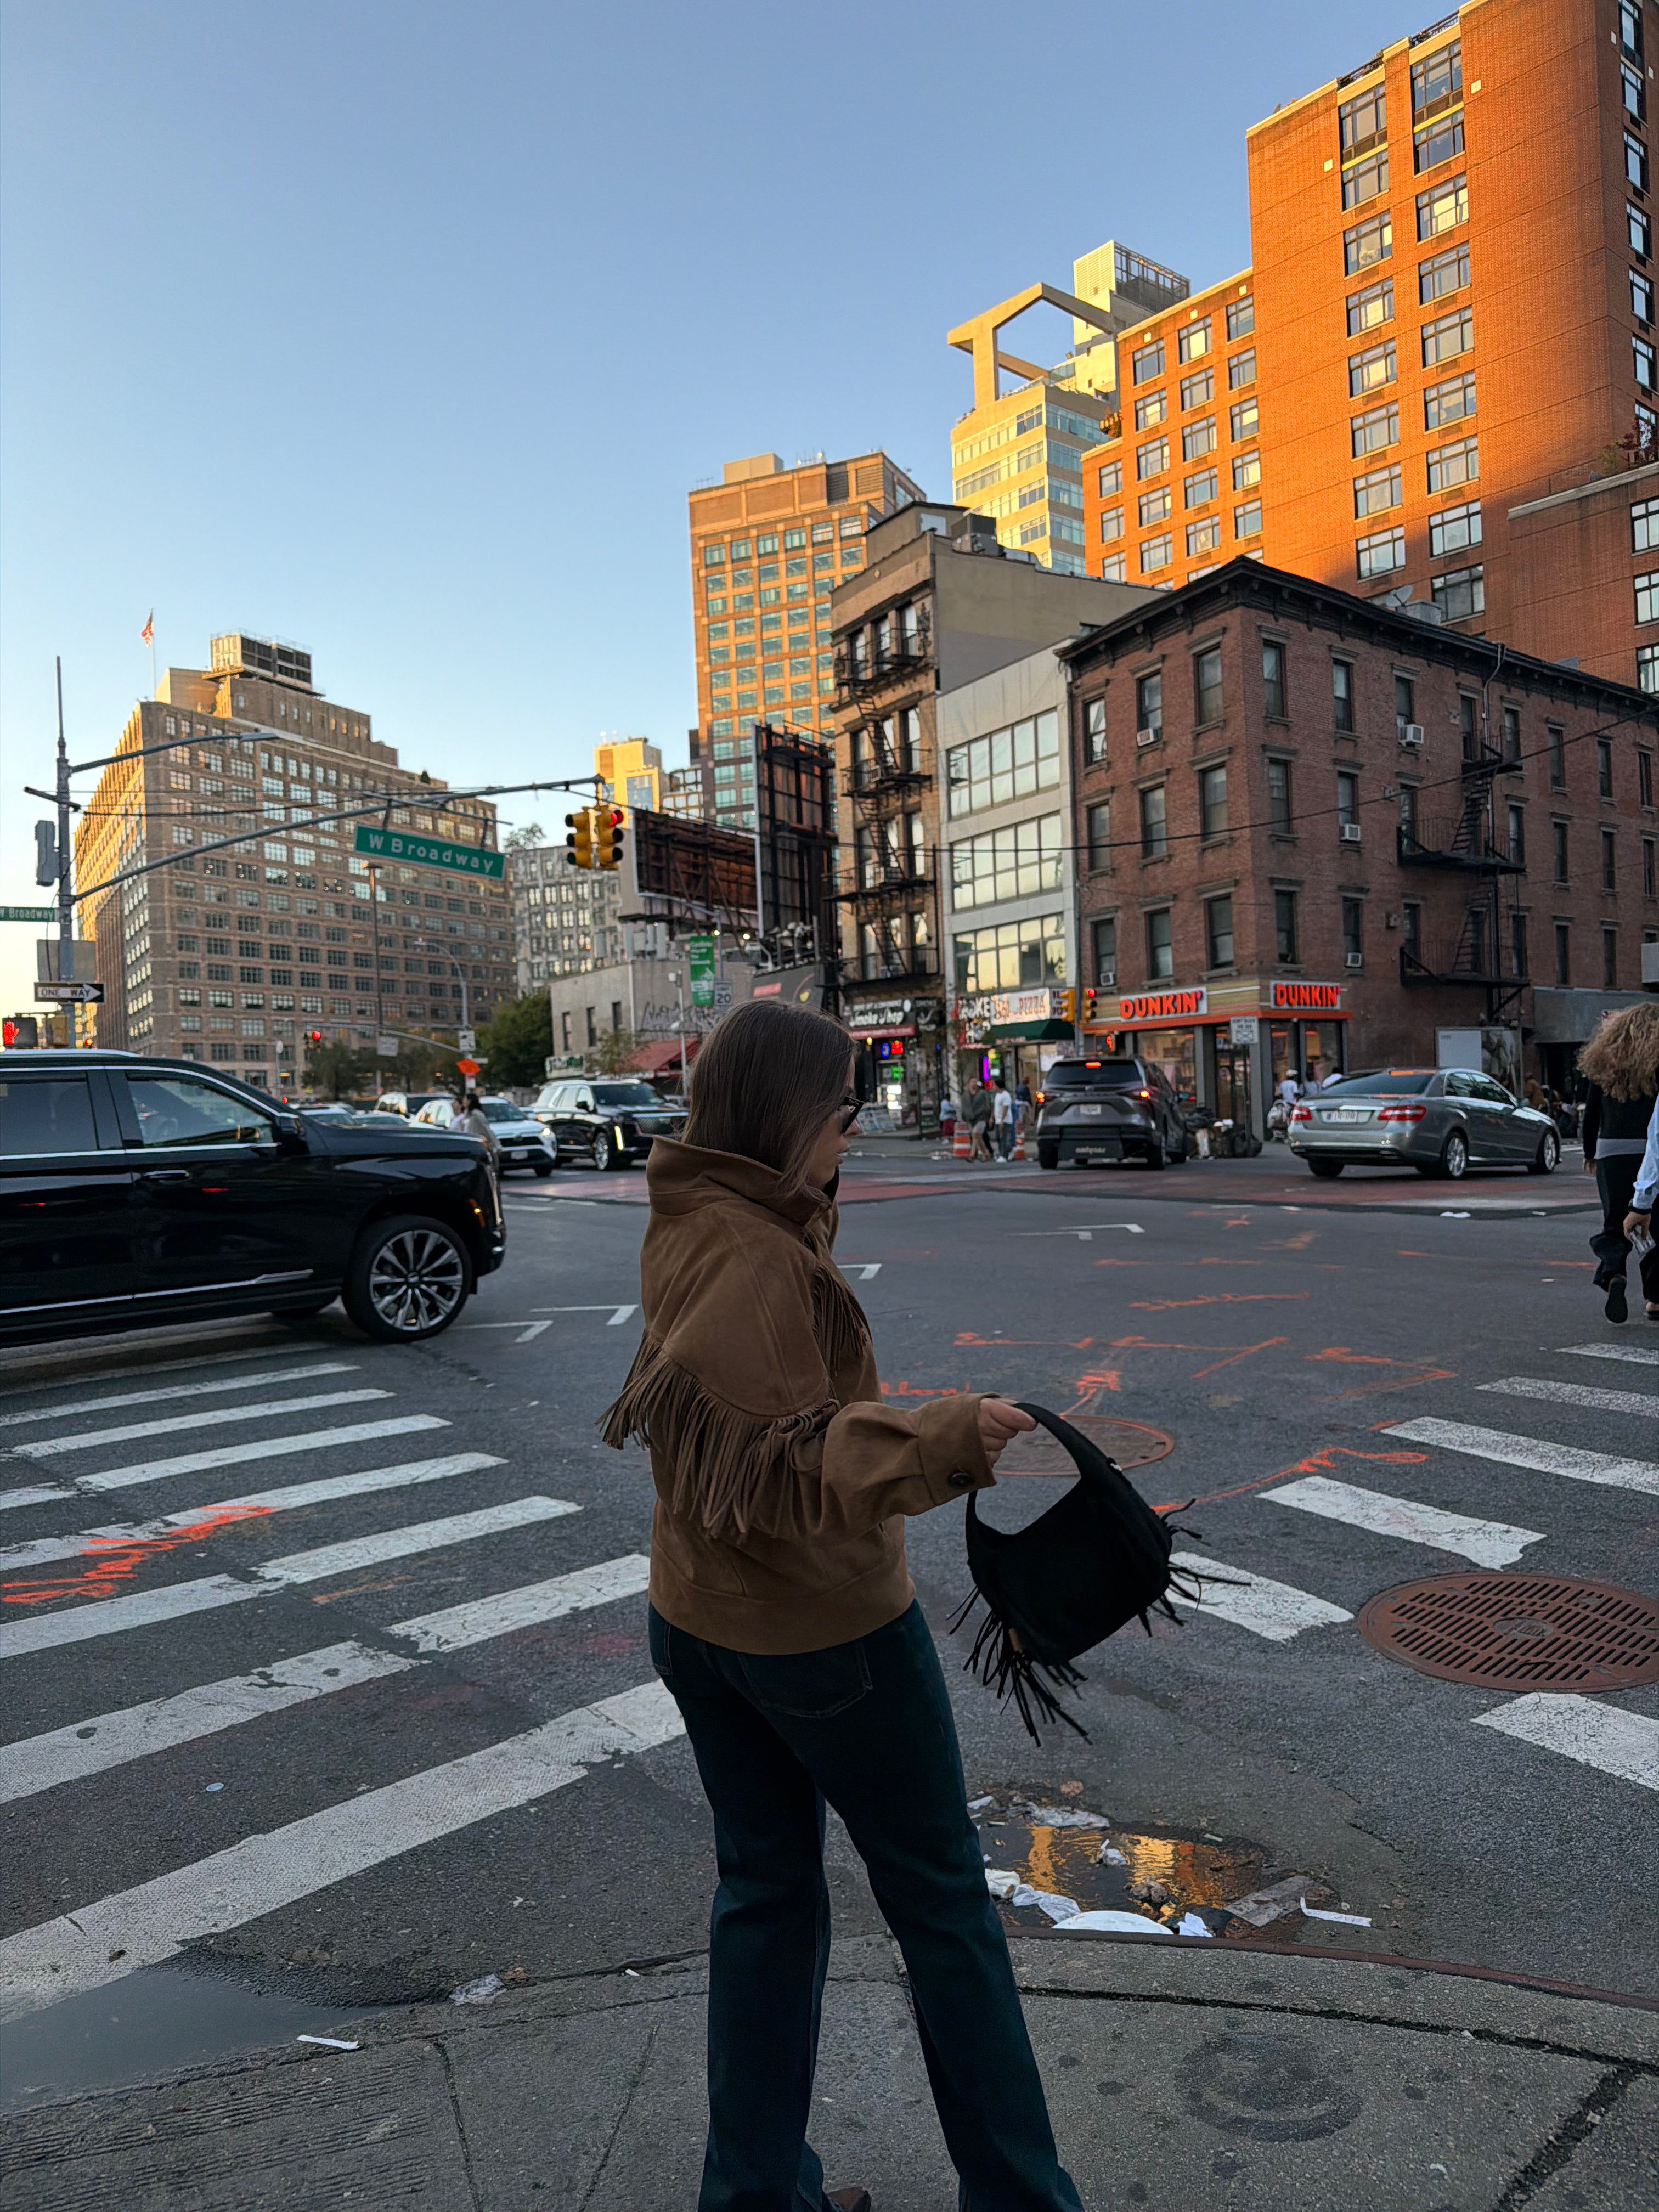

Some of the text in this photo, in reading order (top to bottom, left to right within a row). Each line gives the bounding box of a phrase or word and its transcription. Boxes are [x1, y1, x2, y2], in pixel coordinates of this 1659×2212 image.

[369, 833, 493, 874] W Broadway
[9, 908, 54, 921] Broadway
[717, 994, 731, 1003] 20
[1019, 996, 1046, 1016] PIZZA
[1120, 991, 1201, 1019] DUNKIN'
[1274, 984, 1340, 1007] DUNKIN'
